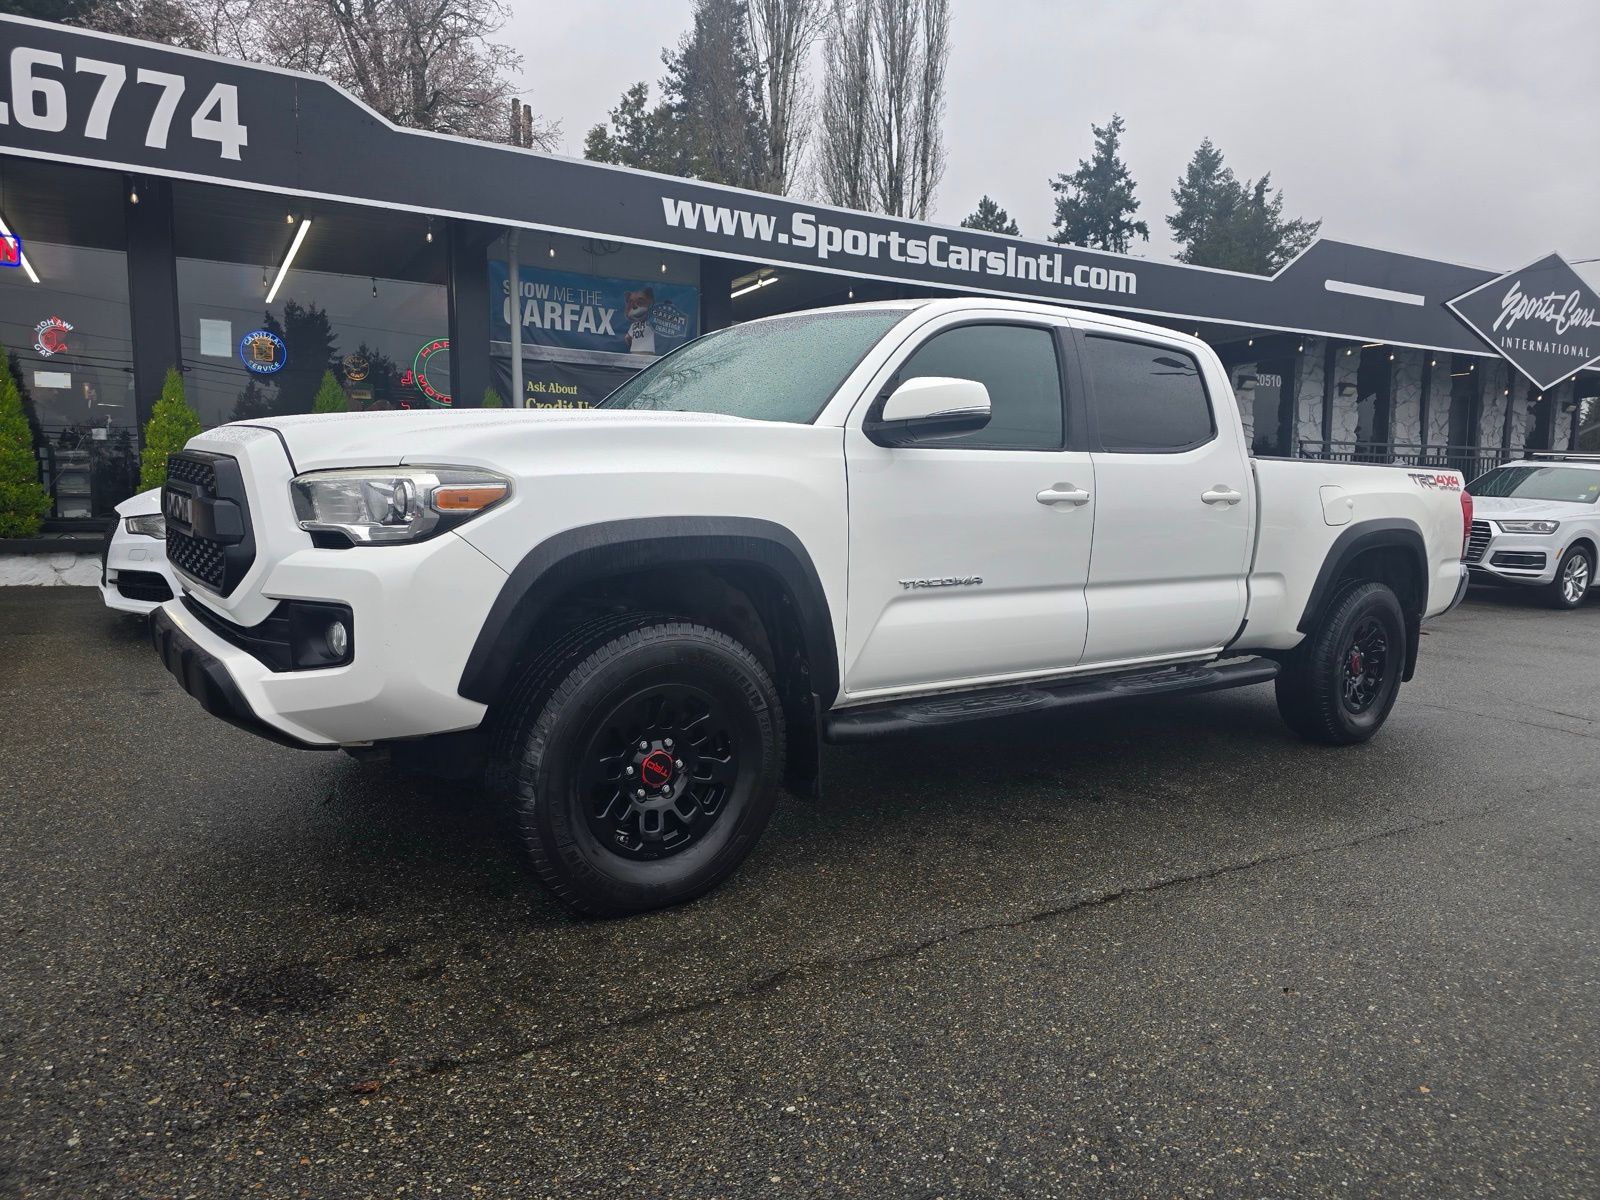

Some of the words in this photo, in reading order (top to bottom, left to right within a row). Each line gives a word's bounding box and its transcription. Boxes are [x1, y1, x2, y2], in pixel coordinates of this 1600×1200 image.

[661, 197, 1137, 295] www.SportsCarsIntl.com
[554, 286, 574, 303] ME
[577, 289, 602, 306] THE
[244, 332, 282, 348] CADILLAC
[1501, 336, 1590, 358] INTERNATIONAL
[249, 360, 280, 372] SERVICE
[527, 381, 546, 393] Ask
[548, 383, 577, 395] About
[1408, 473, 1437, 489] TRD
[898, 576, 983, 589] TACOMA
